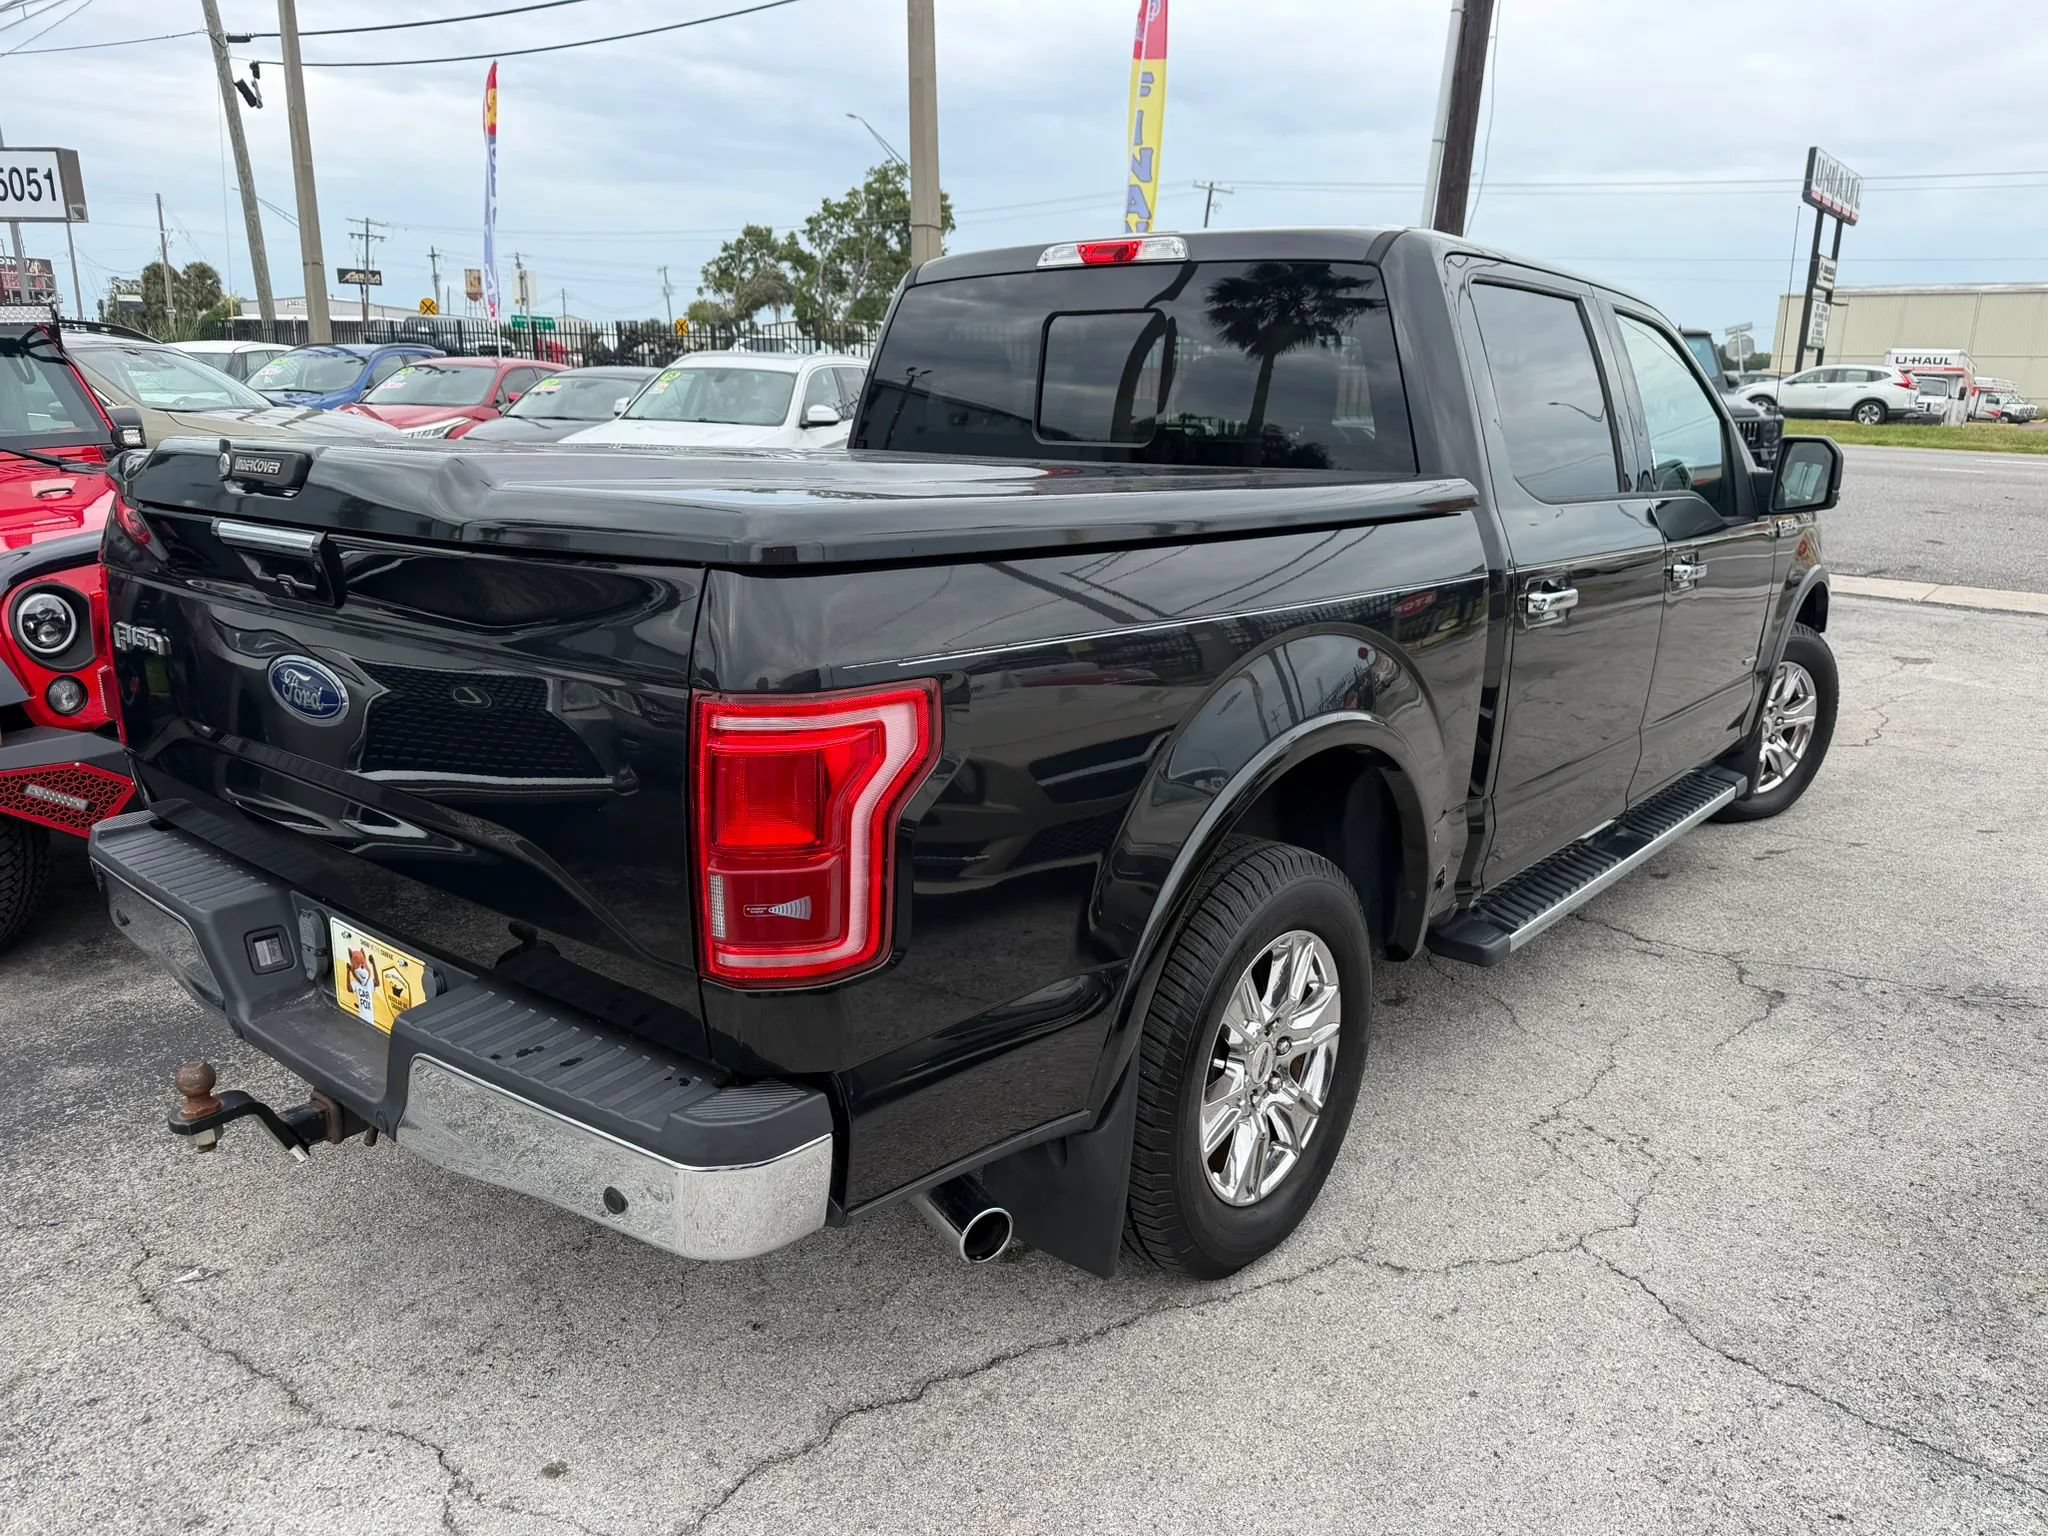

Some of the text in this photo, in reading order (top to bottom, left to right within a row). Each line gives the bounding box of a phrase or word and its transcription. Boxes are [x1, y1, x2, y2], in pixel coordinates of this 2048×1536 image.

[1815, 155, 1861, 210] U-HAUL
[1895, 356, 1952, 365] U-HAUL
[281, 668, 325, 712] Ford
